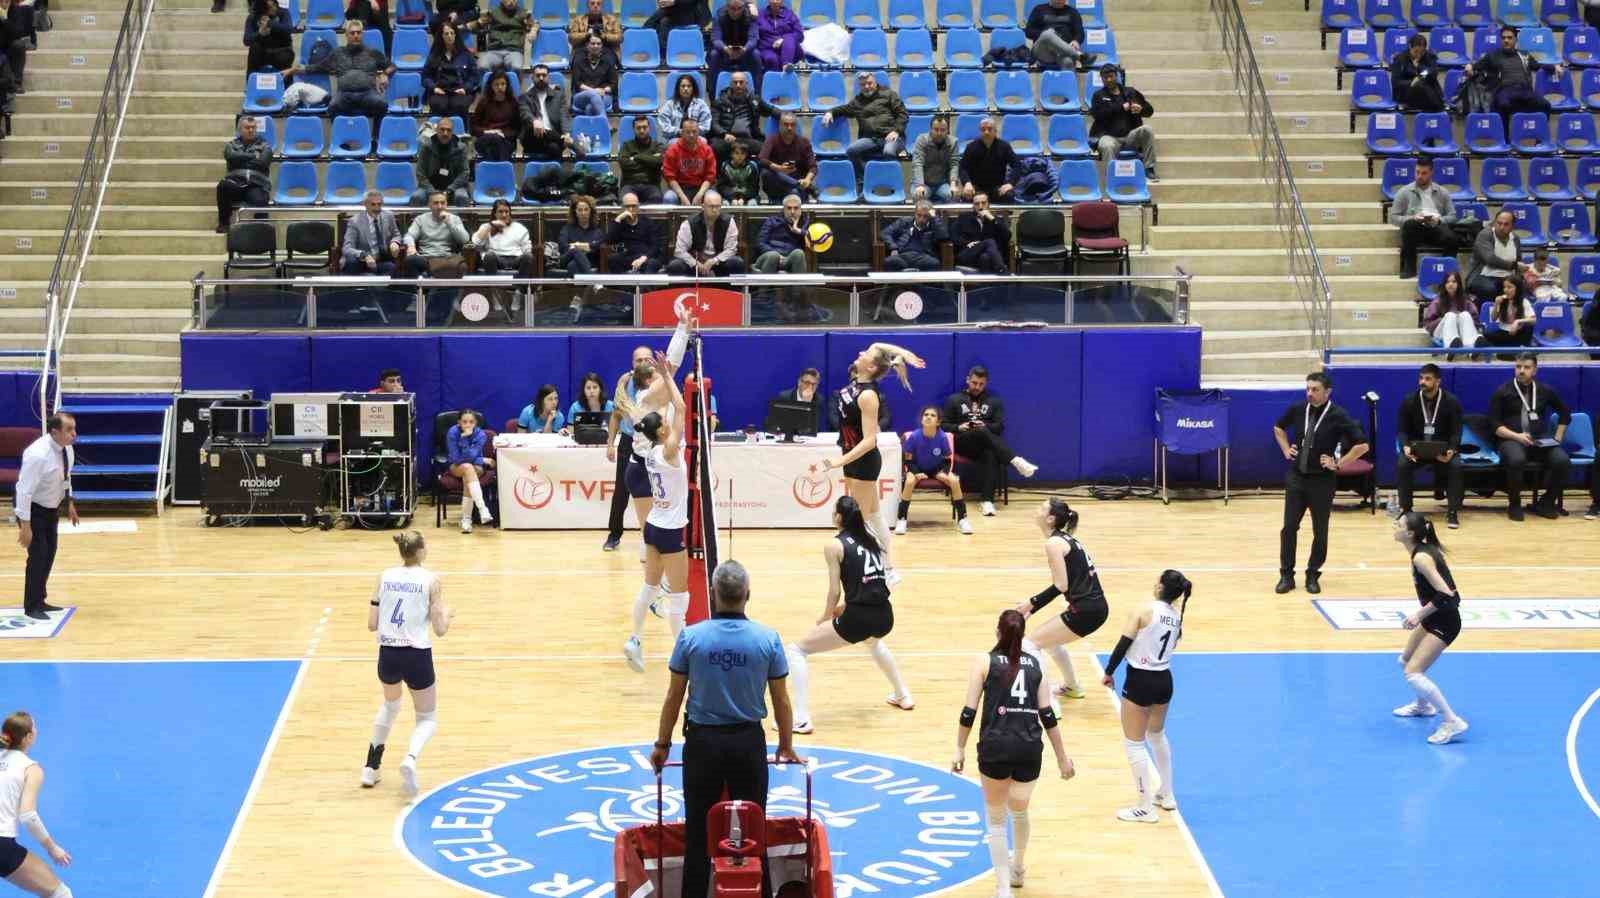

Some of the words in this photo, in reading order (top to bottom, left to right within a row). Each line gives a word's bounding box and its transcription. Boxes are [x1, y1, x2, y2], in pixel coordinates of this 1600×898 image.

[240, 475, 281, 488] mobiled
[560, 480, 617, 501] TVF
[838, 479, 895, 500] TF
[391, 598, 405, 629] 4
[1158, 630, 1171, 661] 1
[1010, 669, 1028, 705] 4
